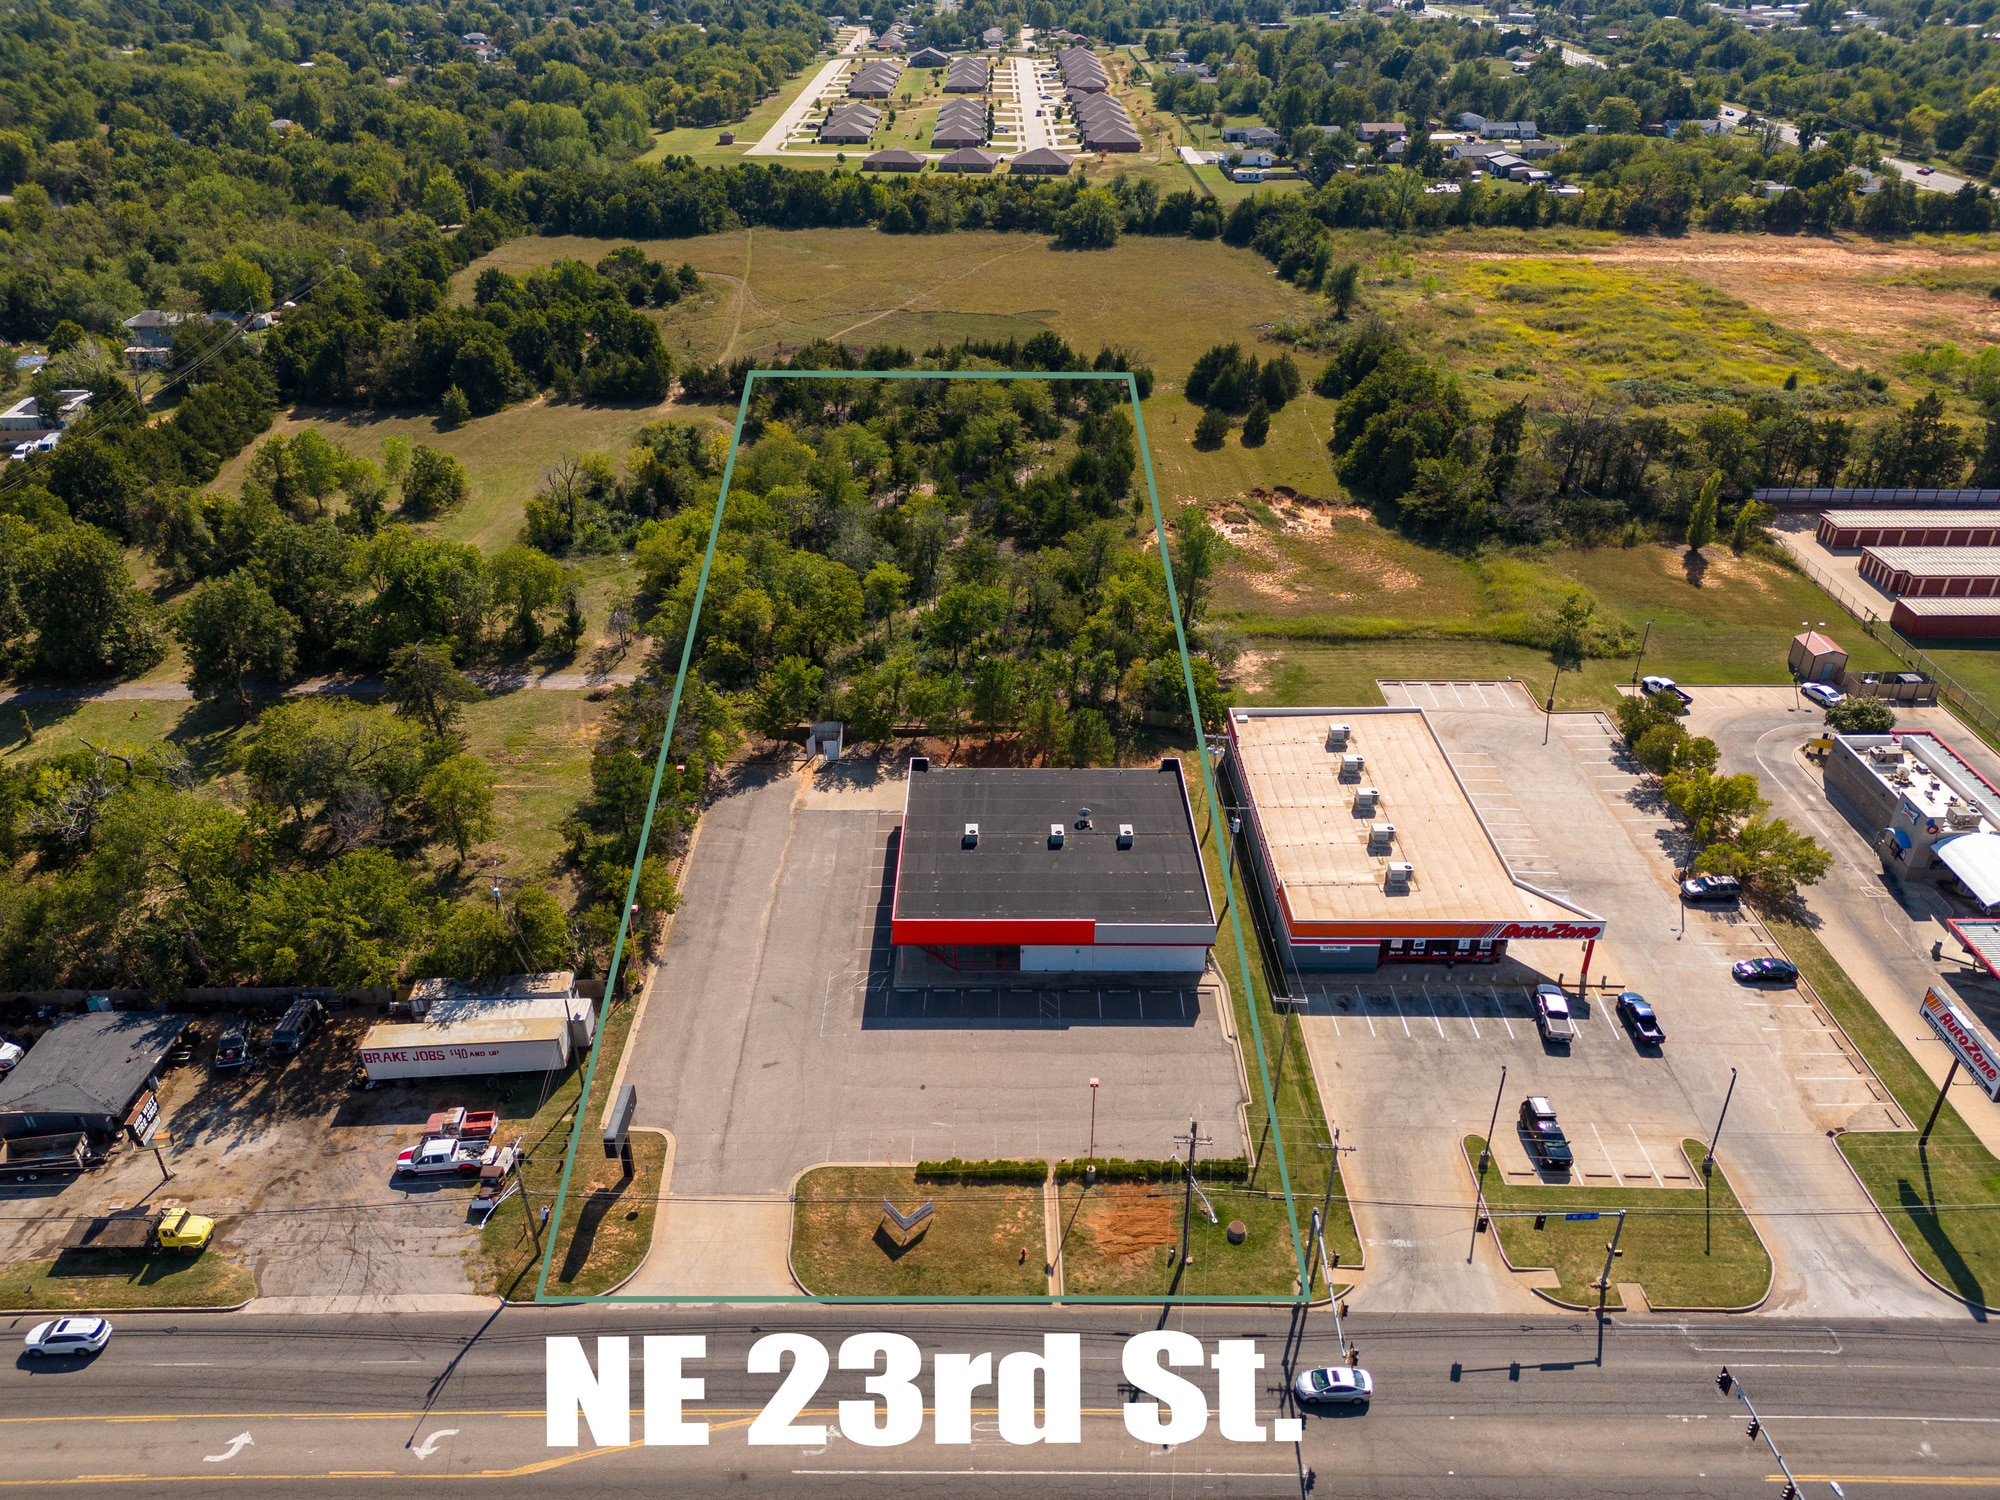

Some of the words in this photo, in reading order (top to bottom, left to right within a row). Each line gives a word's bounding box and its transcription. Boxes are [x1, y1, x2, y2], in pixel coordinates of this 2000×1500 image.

[1497, 923, 1601, 939] AutoZone
[363, 1051, 409, 1064] BRAKE
[413, 1050, 446, 1061] JOBS
[449, 1048, 469, 1059] $40
[1939, 1012, 1997, 1080] AutoZone
[133, 1114, 143, 1130] MID
[142, 1095, 154, 1116] WEST
[136, 1117, 148, 1137] TIRE
[147, 1101, 158, 1122] SHOP
